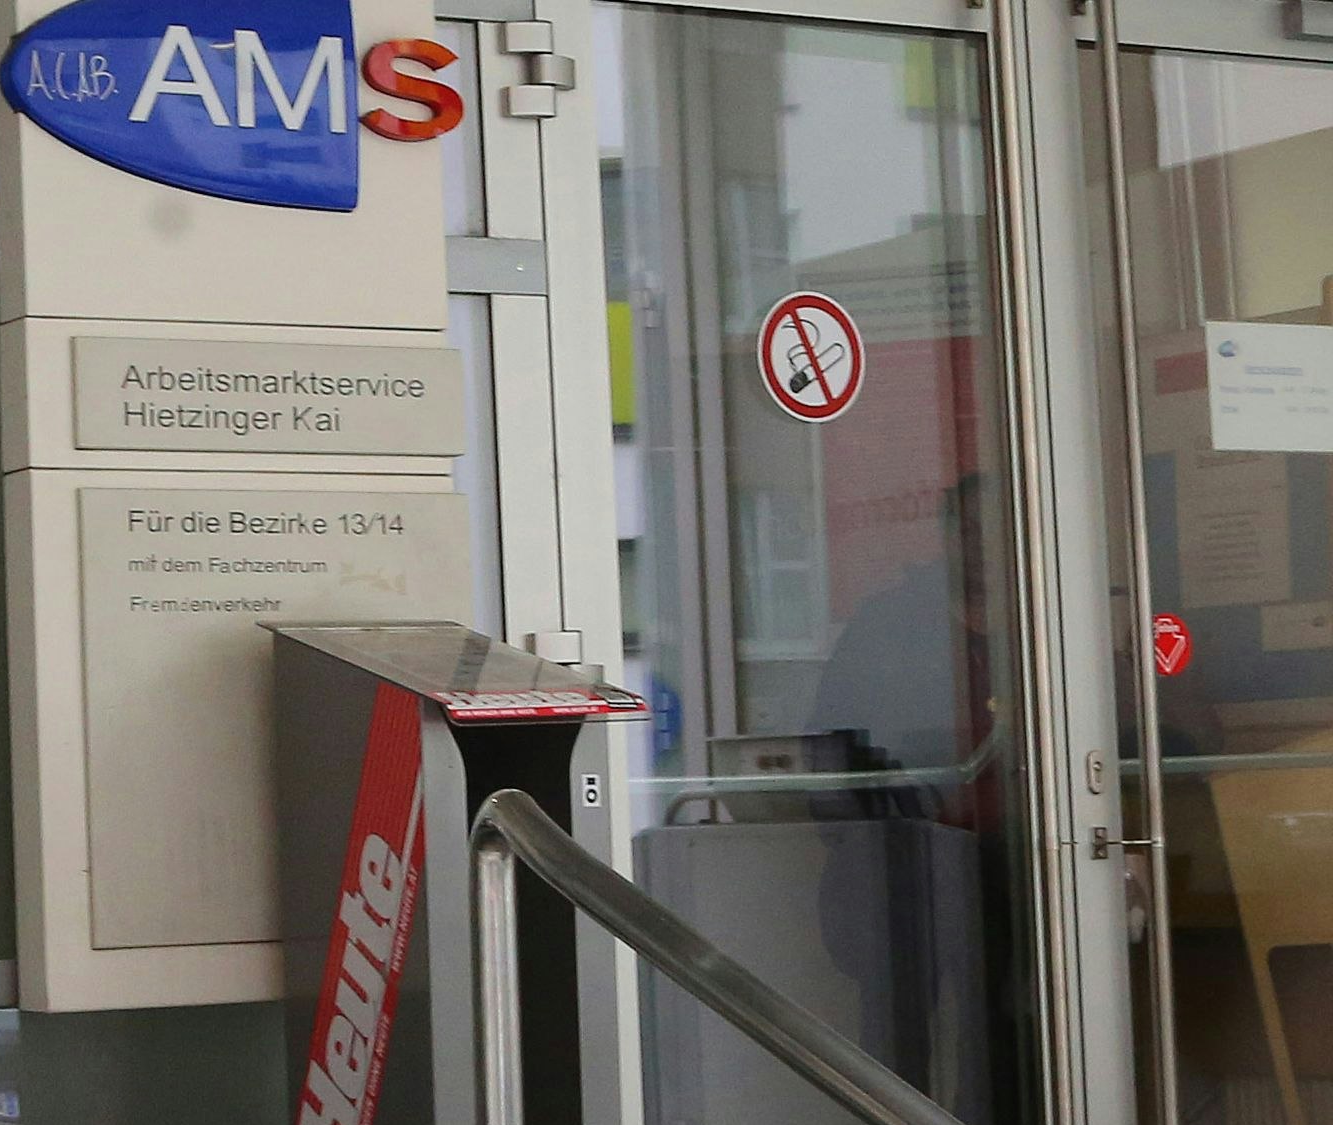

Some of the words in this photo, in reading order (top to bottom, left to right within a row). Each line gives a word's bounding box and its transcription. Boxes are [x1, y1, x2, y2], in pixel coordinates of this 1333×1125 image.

[129, 24, 465, 142] AMS
[121, 364, 426, 398] Arbeitsmarktservice
[123, 401, 283, 436] Hietzinger
[292, 405, 342, 432] Kai
[127, 510, 175, 534] Für
[180, 511, 222, 534] die
[228, 511, 328, 535] Bezirke
[337, 512, 406, 536] 13/14
[128, 554, 157, 572] mit
[161, 555, 202, 573] dem
[208, 556, 329, 574] Fachzentrum
